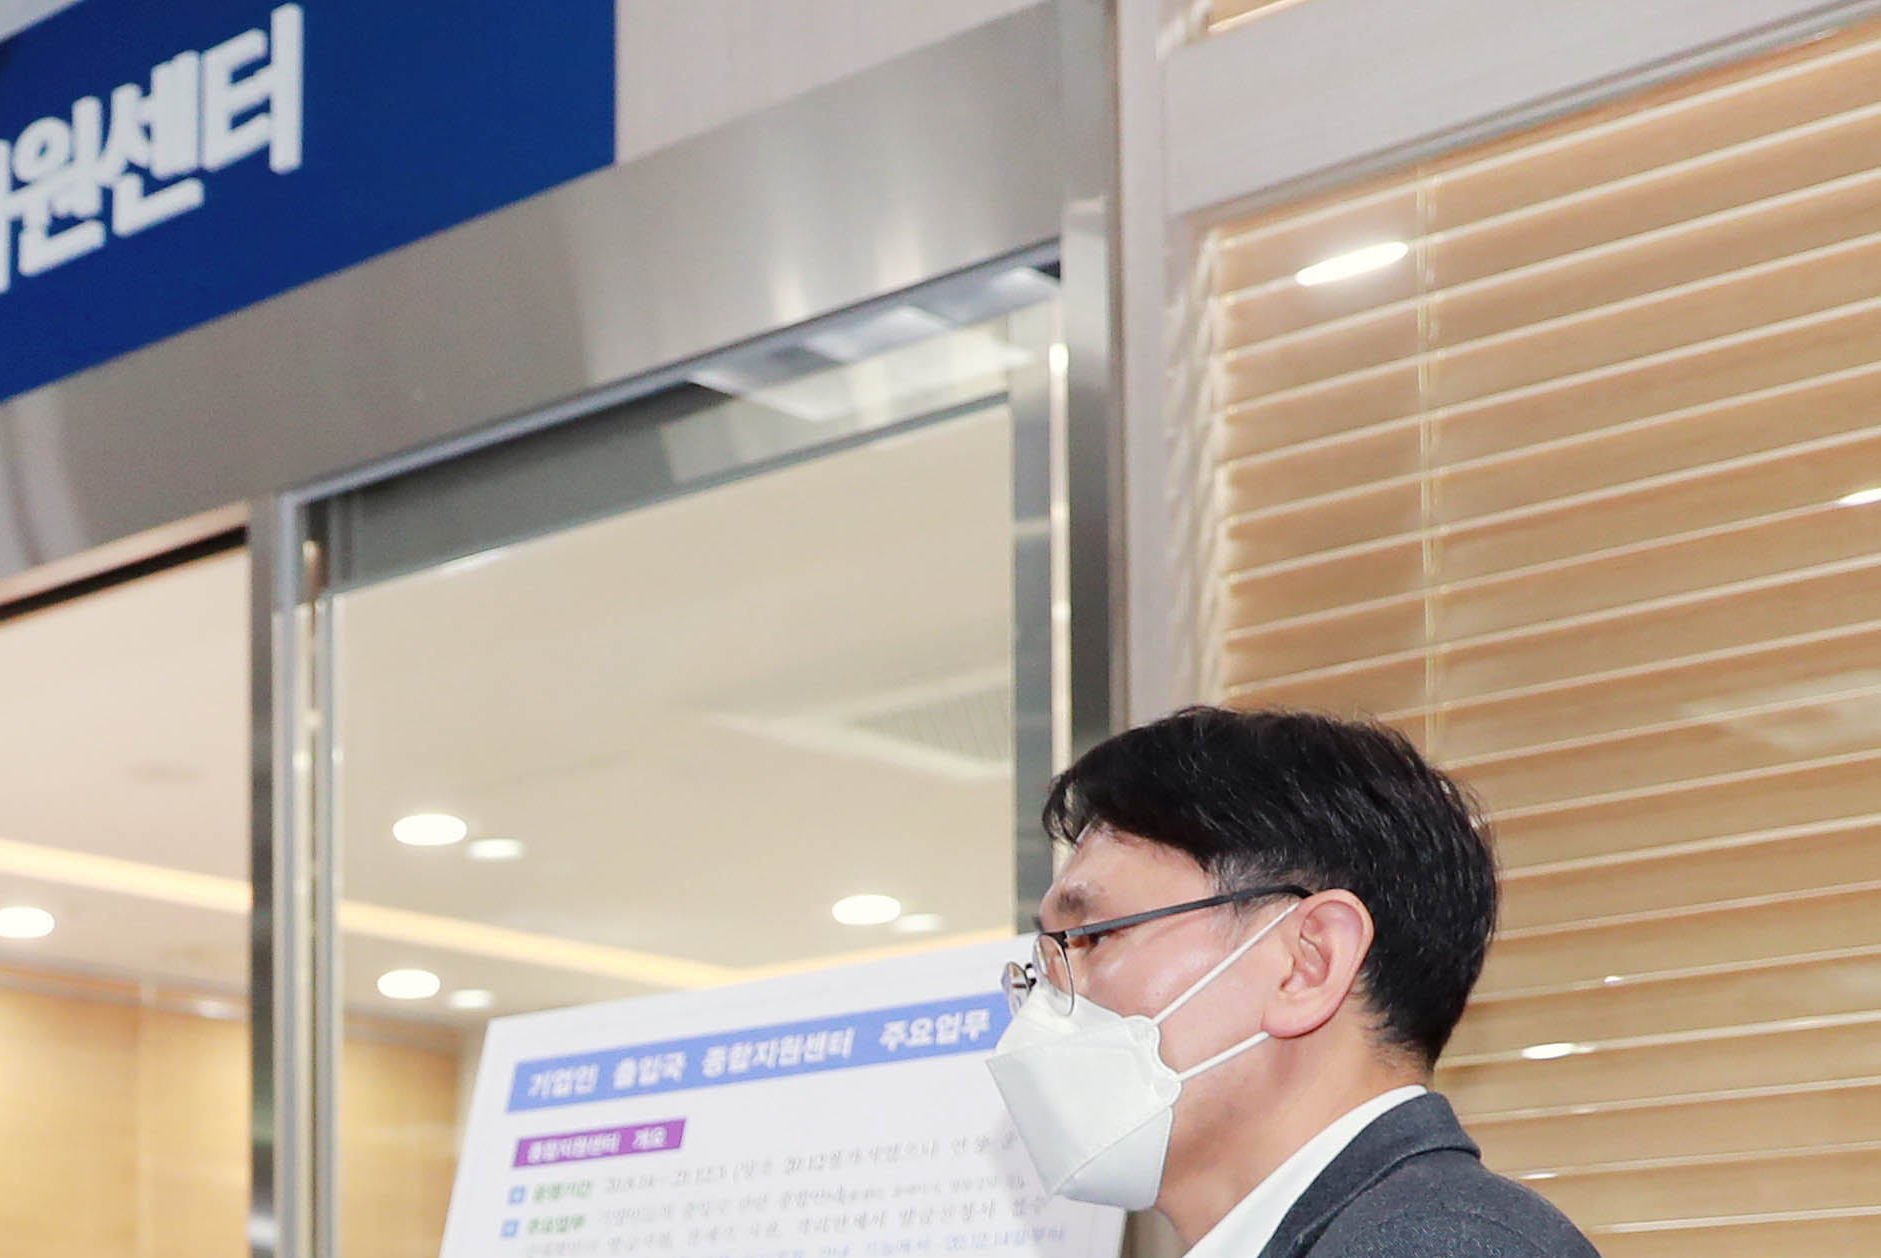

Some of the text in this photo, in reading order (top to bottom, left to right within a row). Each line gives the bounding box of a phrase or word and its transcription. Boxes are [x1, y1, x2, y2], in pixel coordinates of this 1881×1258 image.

[526, 1007, 991, 1101] 기업인 출입국 종합지원센터 주요업무
[526, 1124, 668, 1164] 종합지원센터 개요
